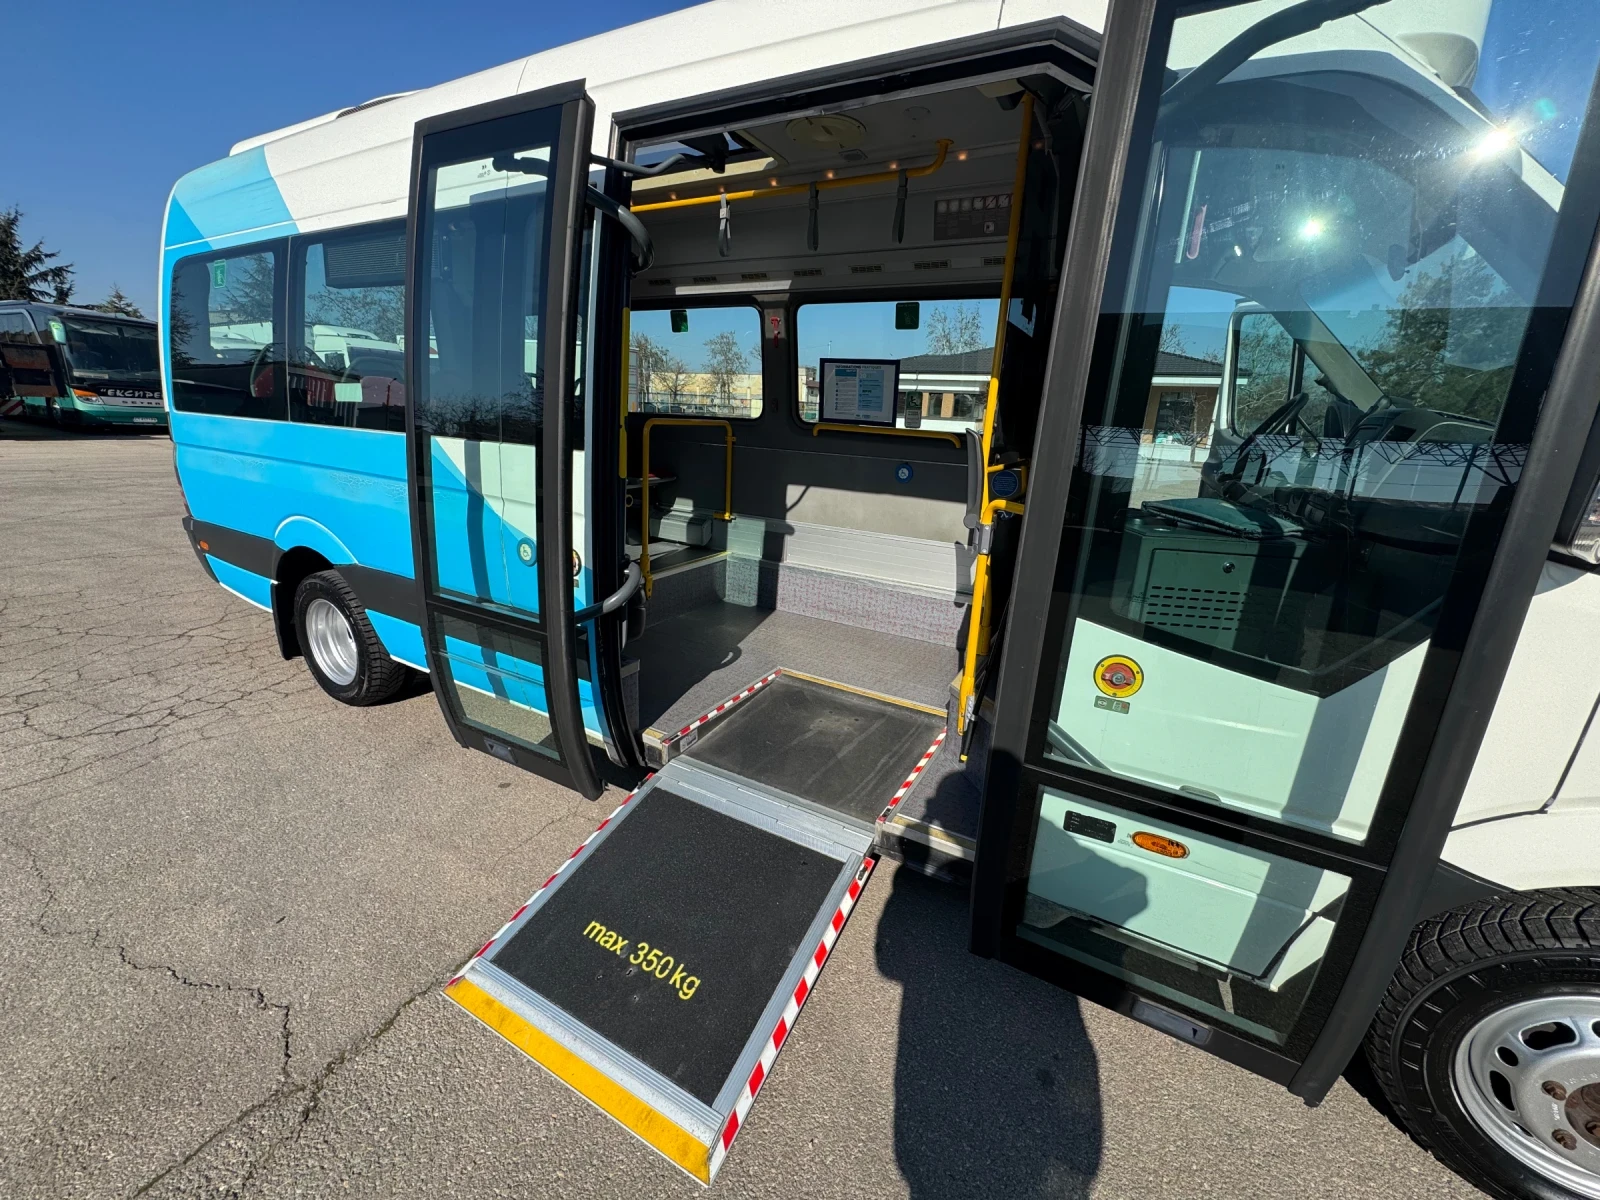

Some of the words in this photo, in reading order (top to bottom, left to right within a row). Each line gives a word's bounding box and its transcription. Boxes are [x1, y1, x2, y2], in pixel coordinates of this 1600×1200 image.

[583, 921, 629, 955] max
[629, 942, 674, 978] 350
[668, 963, 701, 1000] kg
